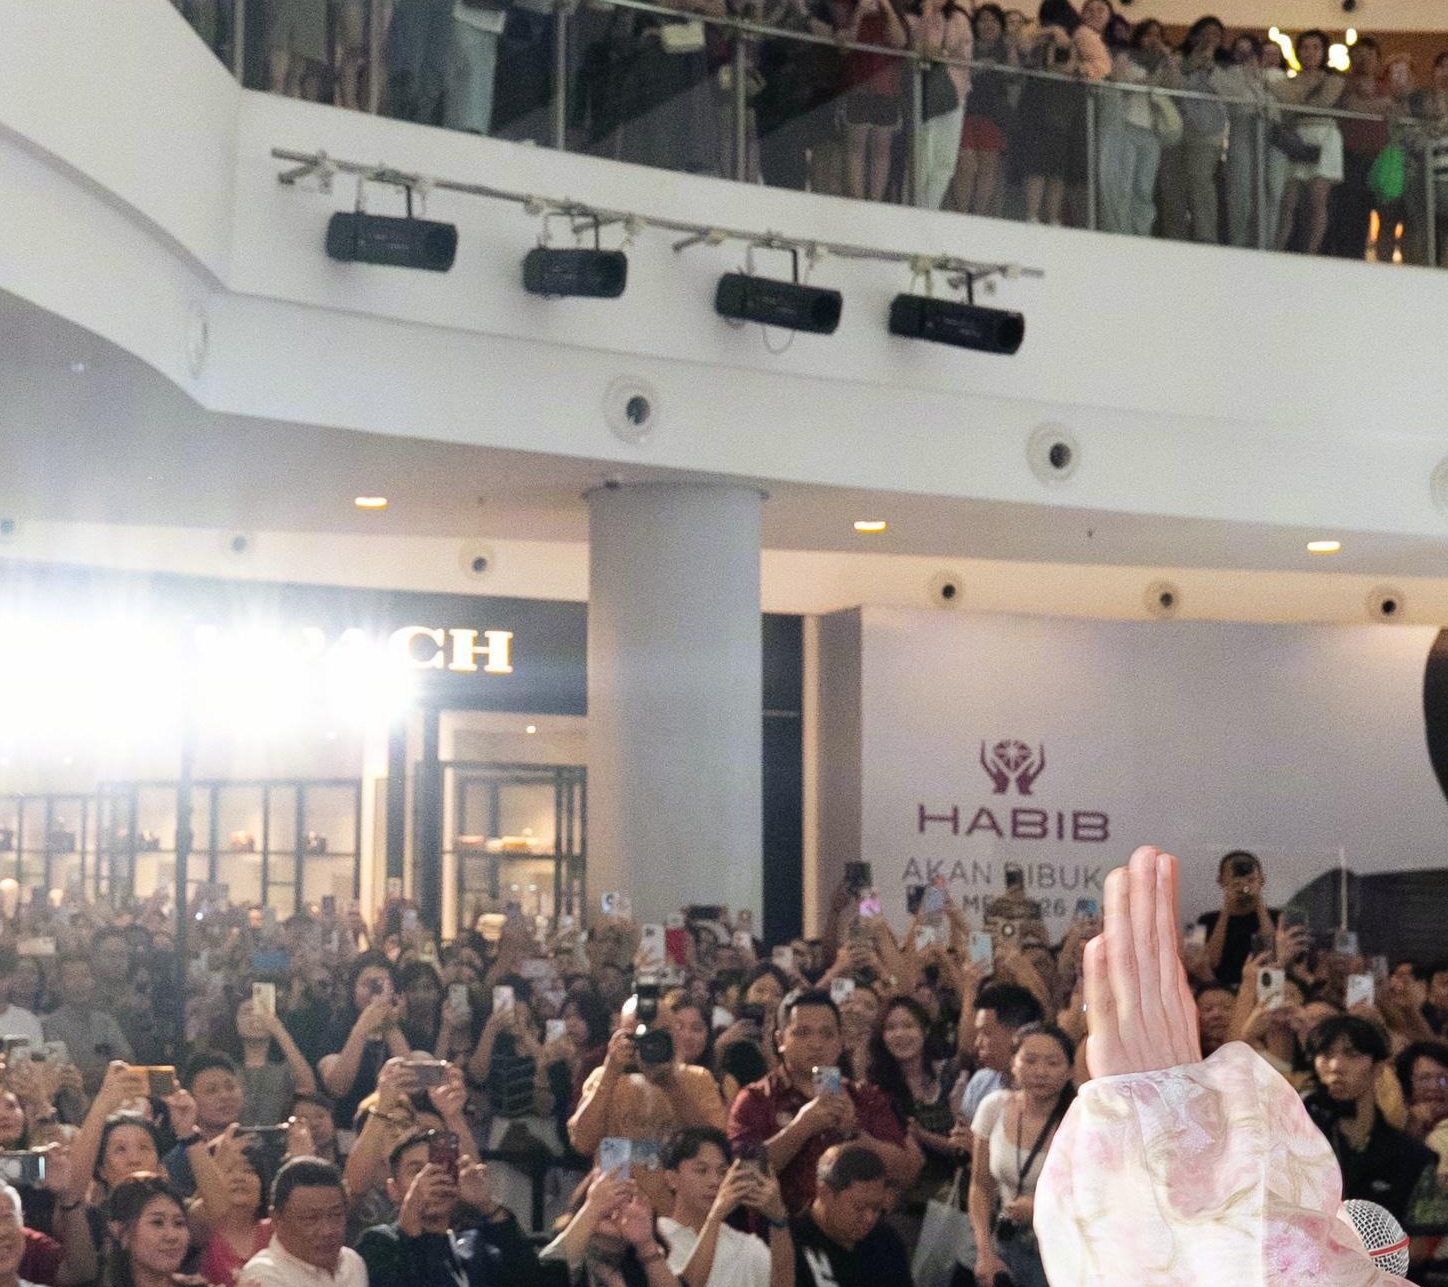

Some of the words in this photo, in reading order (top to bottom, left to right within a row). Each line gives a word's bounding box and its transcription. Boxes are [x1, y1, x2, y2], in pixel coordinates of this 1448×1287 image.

[918, 804, 1110, 842] HABIB
[902, 857, 993, 885] AKAN
[1004, 861, 1103, 890] IBUK
